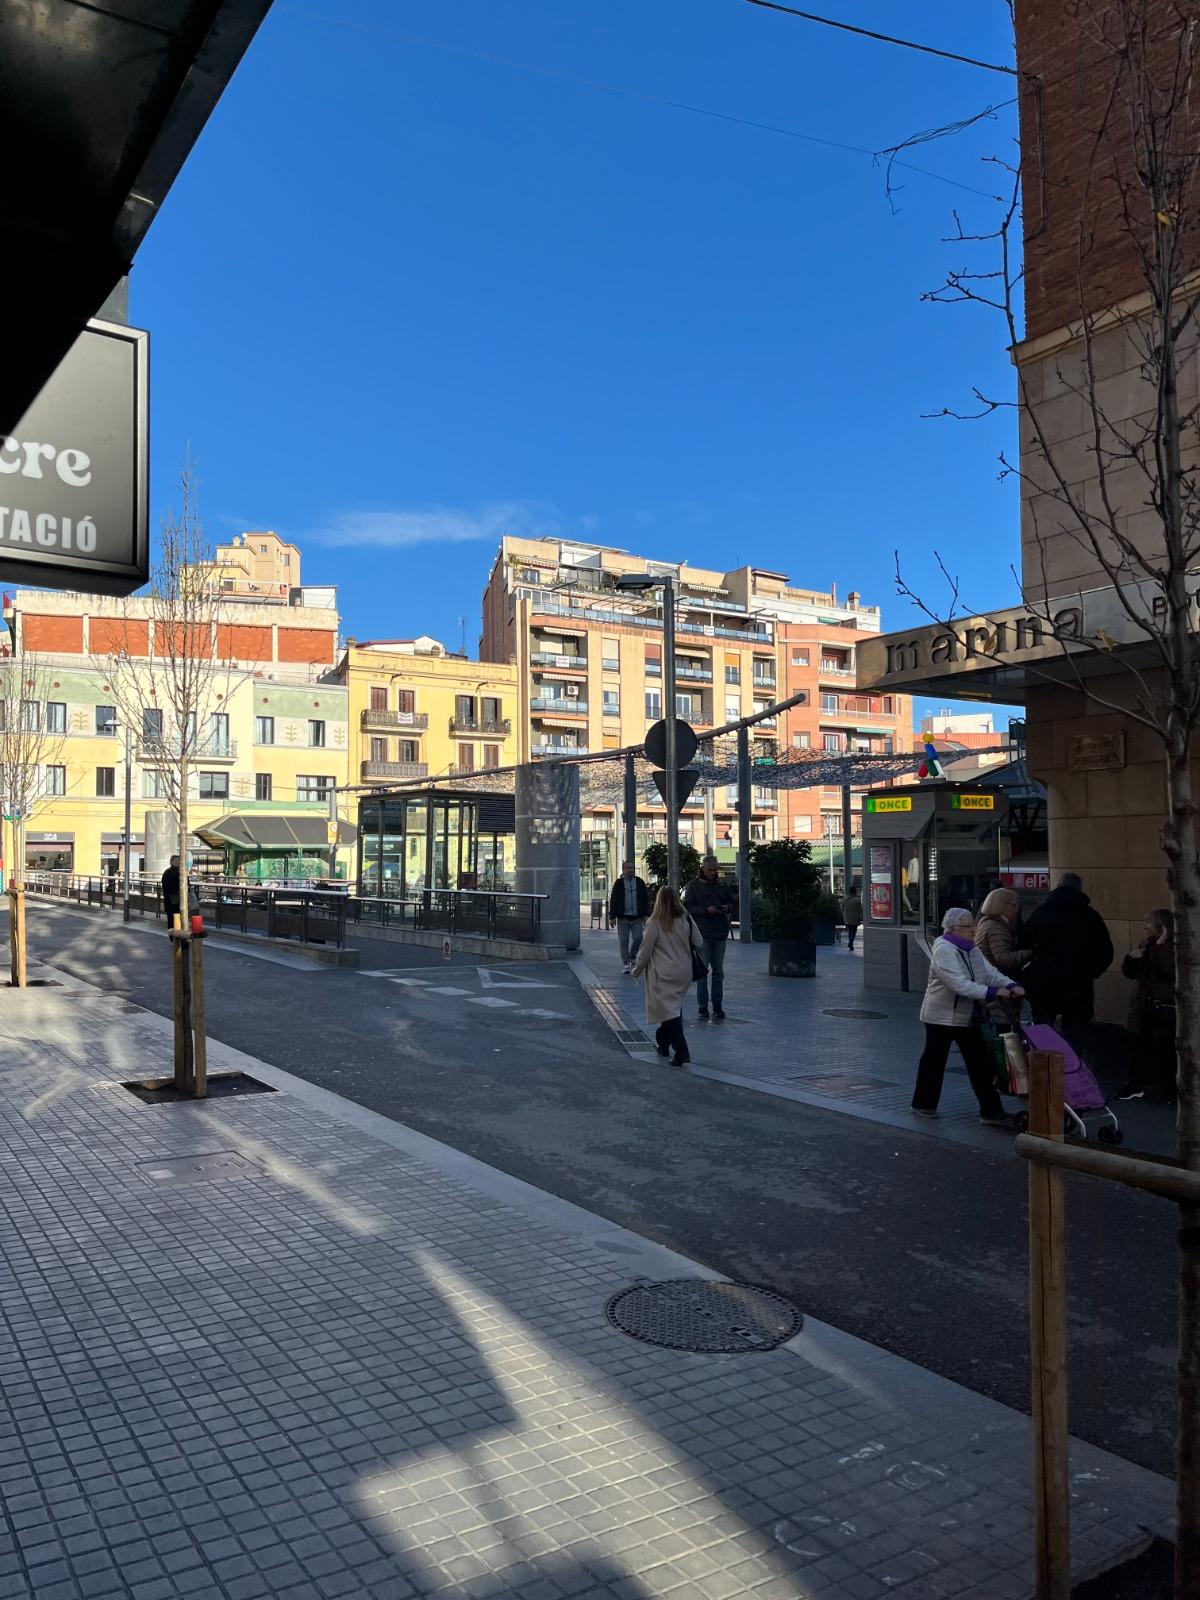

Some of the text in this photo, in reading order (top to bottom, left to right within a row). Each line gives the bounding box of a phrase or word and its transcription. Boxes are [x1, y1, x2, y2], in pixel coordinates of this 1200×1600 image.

[885, 607, 1084, 674] marina
[879, 799, 908, 810] ONCE
[963, 797, 990, 808] ONCE
